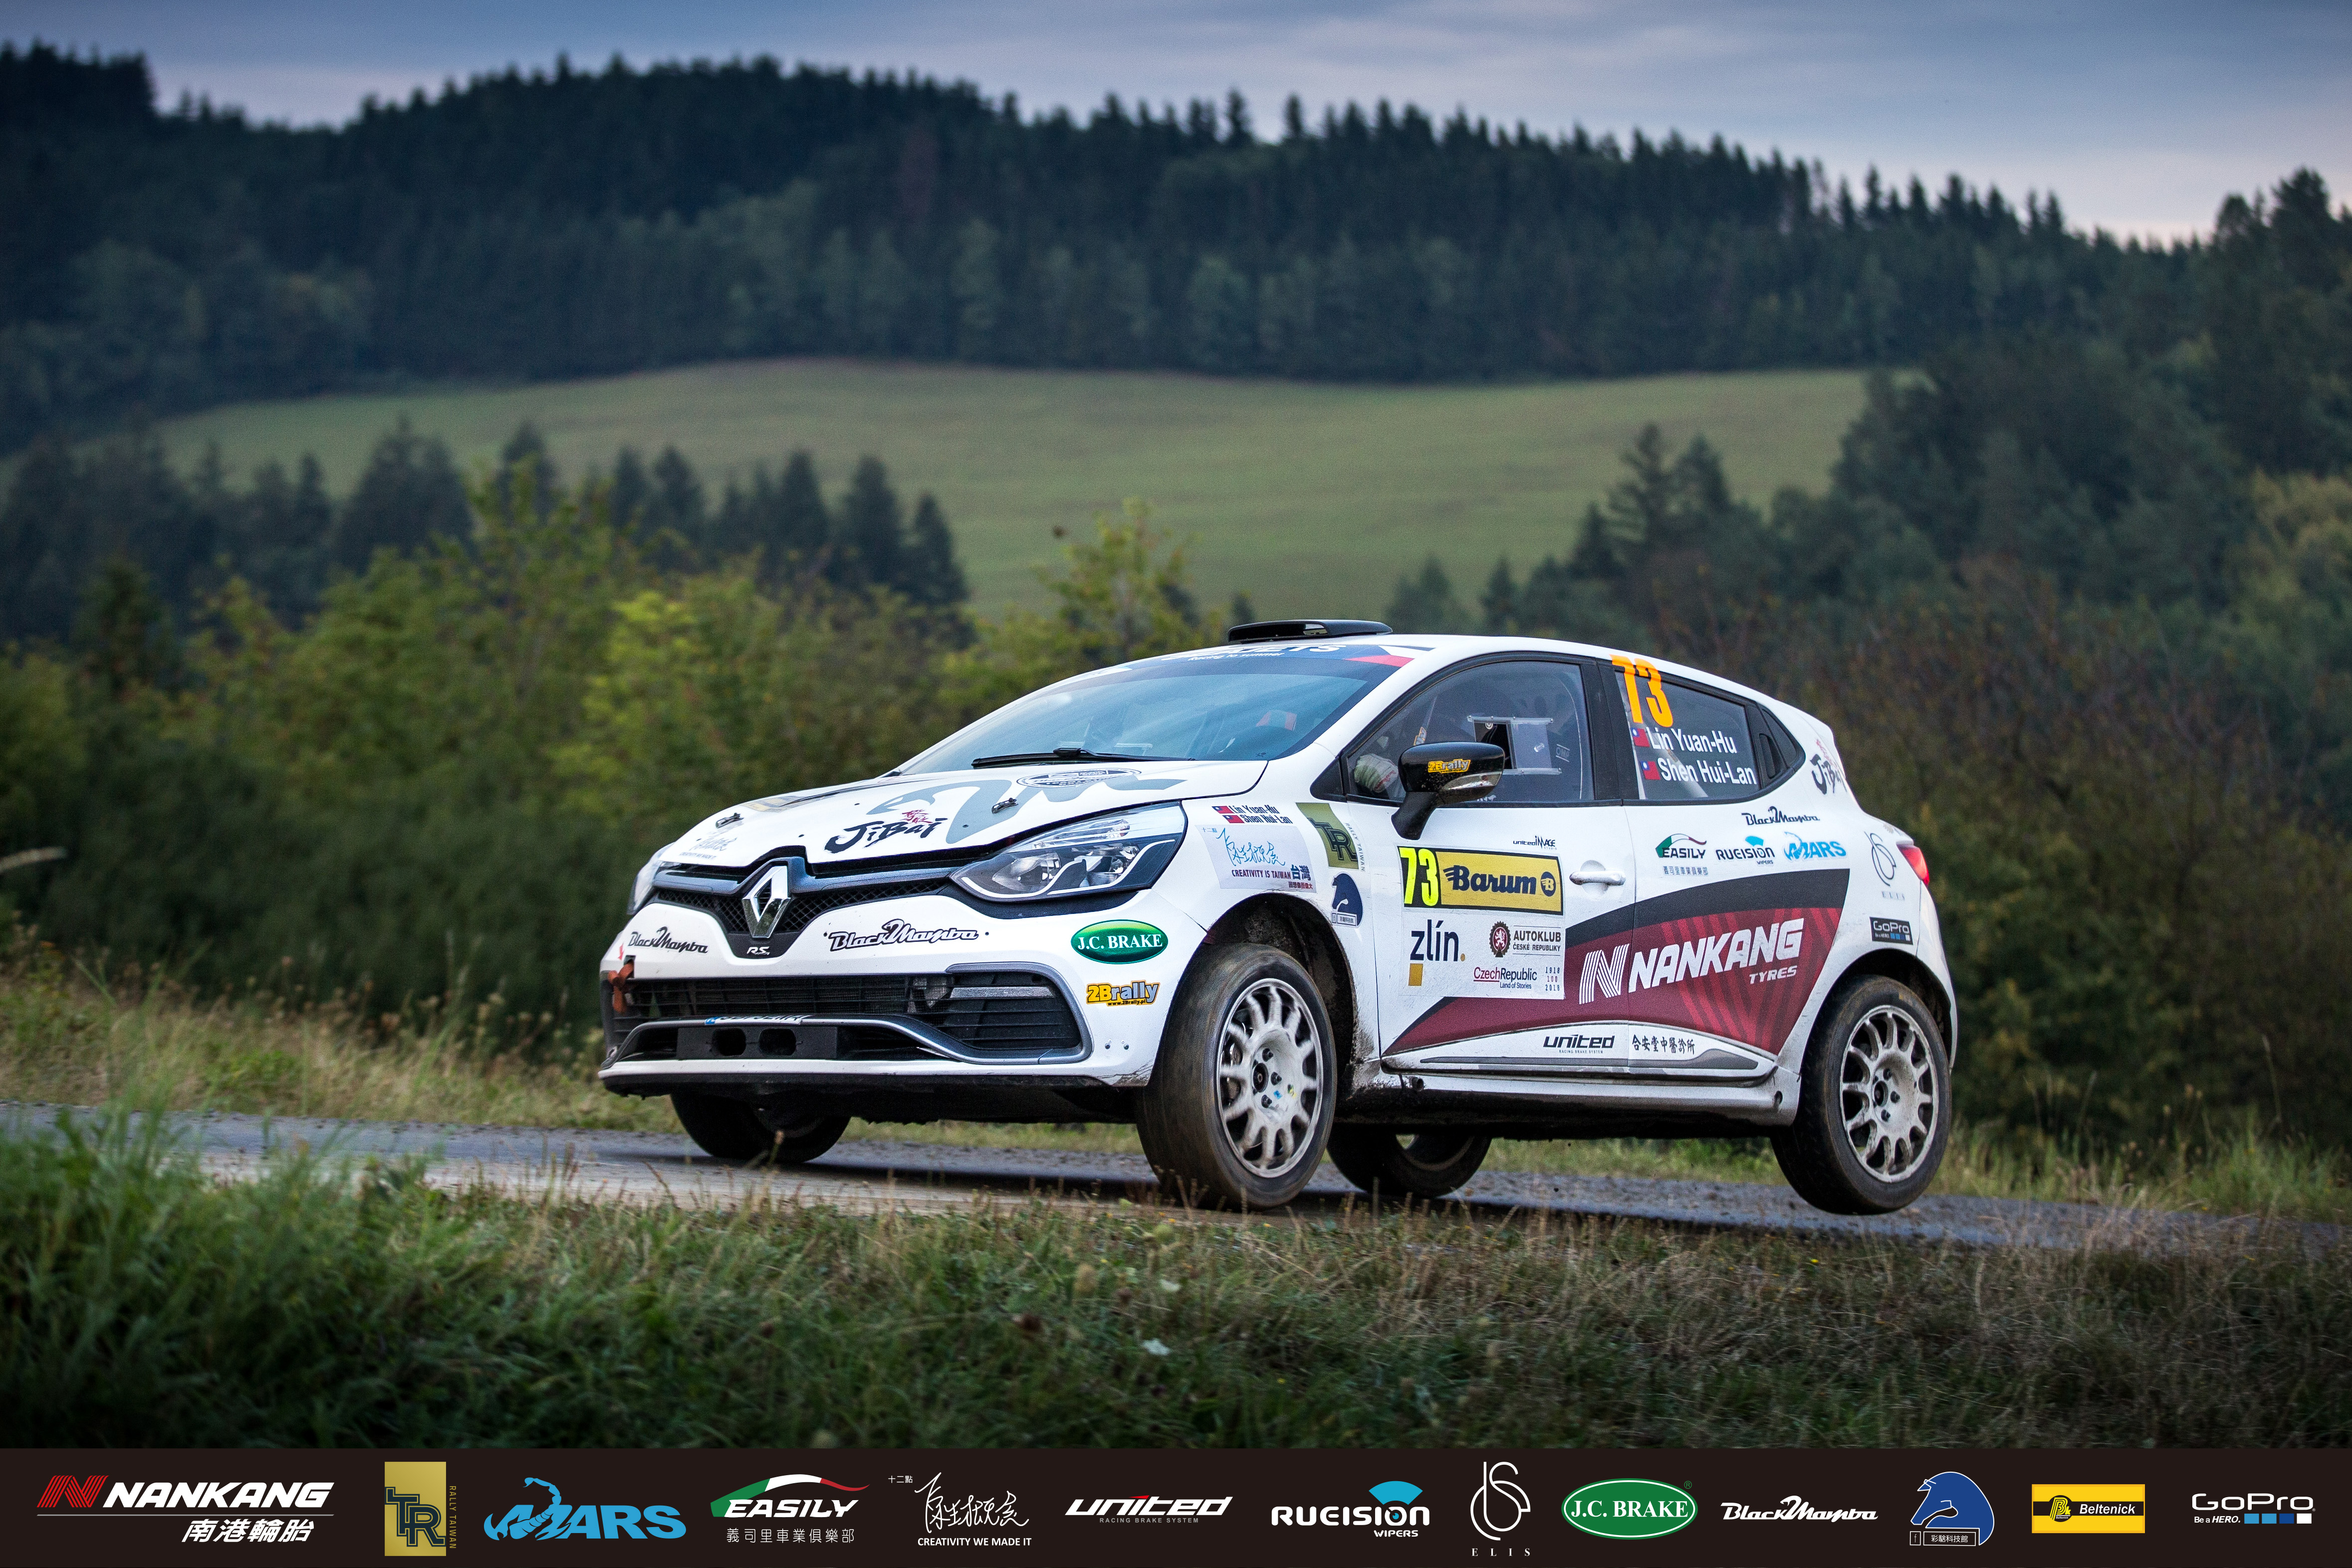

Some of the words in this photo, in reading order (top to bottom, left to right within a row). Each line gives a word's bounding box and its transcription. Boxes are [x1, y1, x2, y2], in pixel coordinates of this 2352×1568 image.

[1610, 654, 1673, 727] 73
[1647, 728, 1673, 750] Lin
[1674, 728, 1737, 754] Yuan-Hu
[1428, 760, 1469, 771] 2Brally
[1657, 758, 1699, 782] Shen
[1700, 761, 1757, 785] Hui-Lan
[1228, 805, 1246, 814] Lin
[1241, 805, 1280, 814] Yuan-Hu
[1239, 814, 1264, 823] Shen
[1260, 814, 1293, 824] Hui-Lan
[1345, 823, 1358, 841] RALLY
[1662, 848, 1706, 859] EASILY
[1271, 871, 1291, 880] TAIWAN
[1399, 847, 1439, 906] 73
[1443, 865, 1537, 895] Barum
[830, 918, 979, 952] BlackMamba
[1873, 920, 1909, 934] GoPro
[628, 926, 708, 953] BlackMamba
[1077, 936, 1104, 950] J.C.
[1108, 934, 1163, 949] BRAKE
[1513, 930, 1561, 942] AUTOKLUB
[1513, 941, 1530, 950] ČESKÉ
[1629, 918, 1804, 993] NANKANG
[1474, 967, 1537, 982] CzechRepublic
[1749, 965, 1798, 984] TYRES
[1087, 981, 1161, 1003] 2Brally
[1543, 1034, 1615, 1048] united
